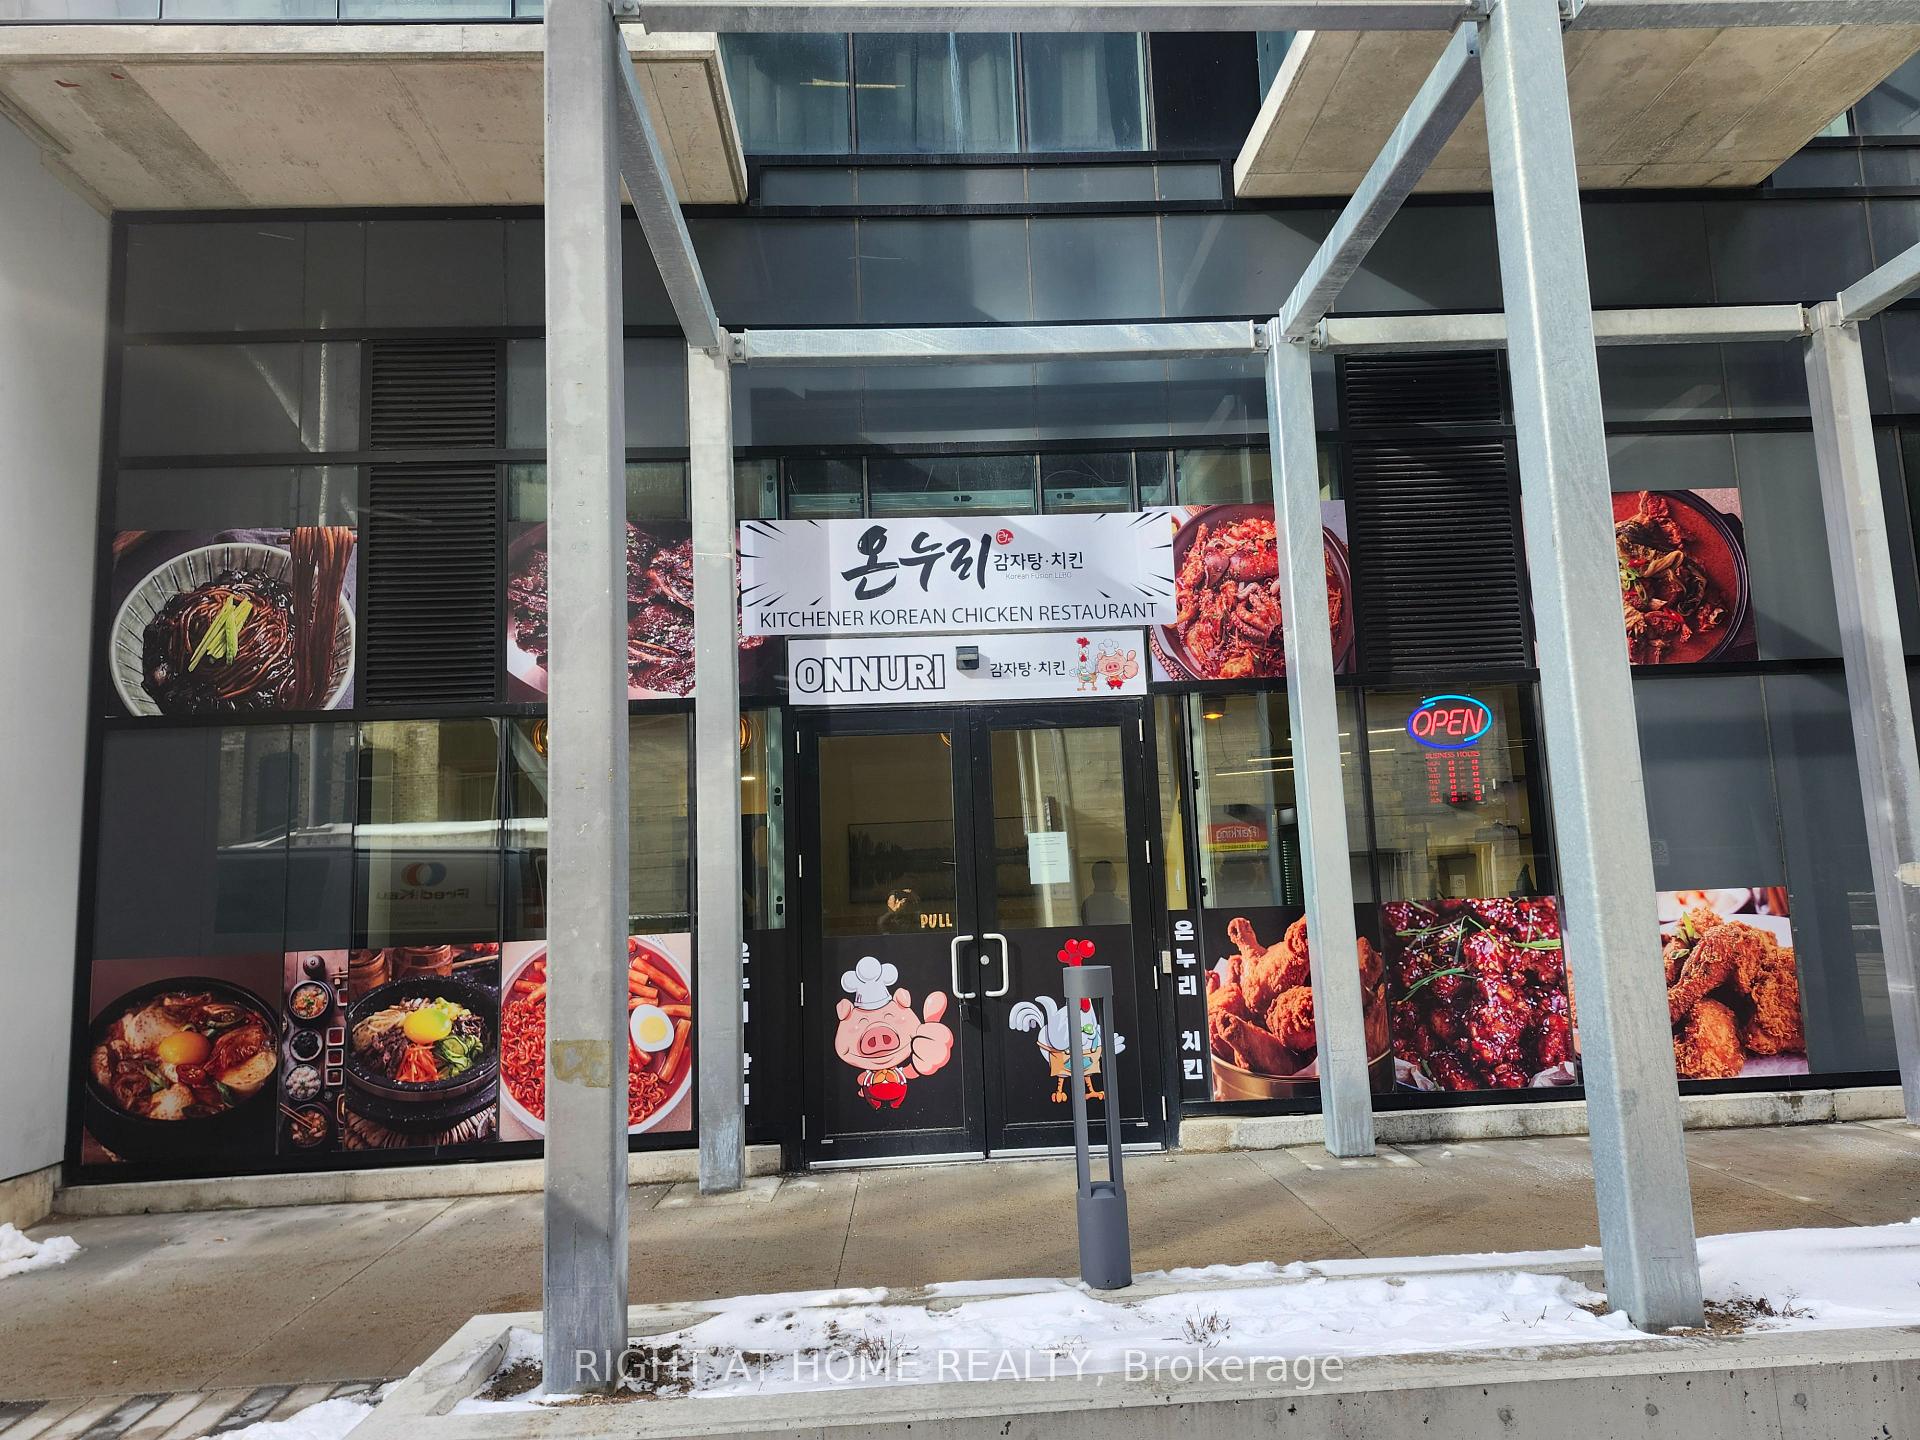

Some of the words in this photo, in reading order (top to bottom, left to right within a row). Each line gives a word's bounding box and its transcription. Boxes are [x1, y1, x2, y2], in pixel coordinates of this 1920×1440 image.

[841, 525, 992, 600] 온누리
[760, 610, 864, 628] KITCHENER
[870, 608, 946, 626] KOREAN
[952, 605, 1033, 624] CHICKEN
[1040, 602, 1158, 621] RESTAURANT
[795, 653, 946, 693] ONNURI
[1413, 708, 1484, 736] OPEN
[920, 913, 953, 928] PULL
[1174, 919, 1197, 996] 온누리
[1181, 1030, 1204, 1080] 치킨
